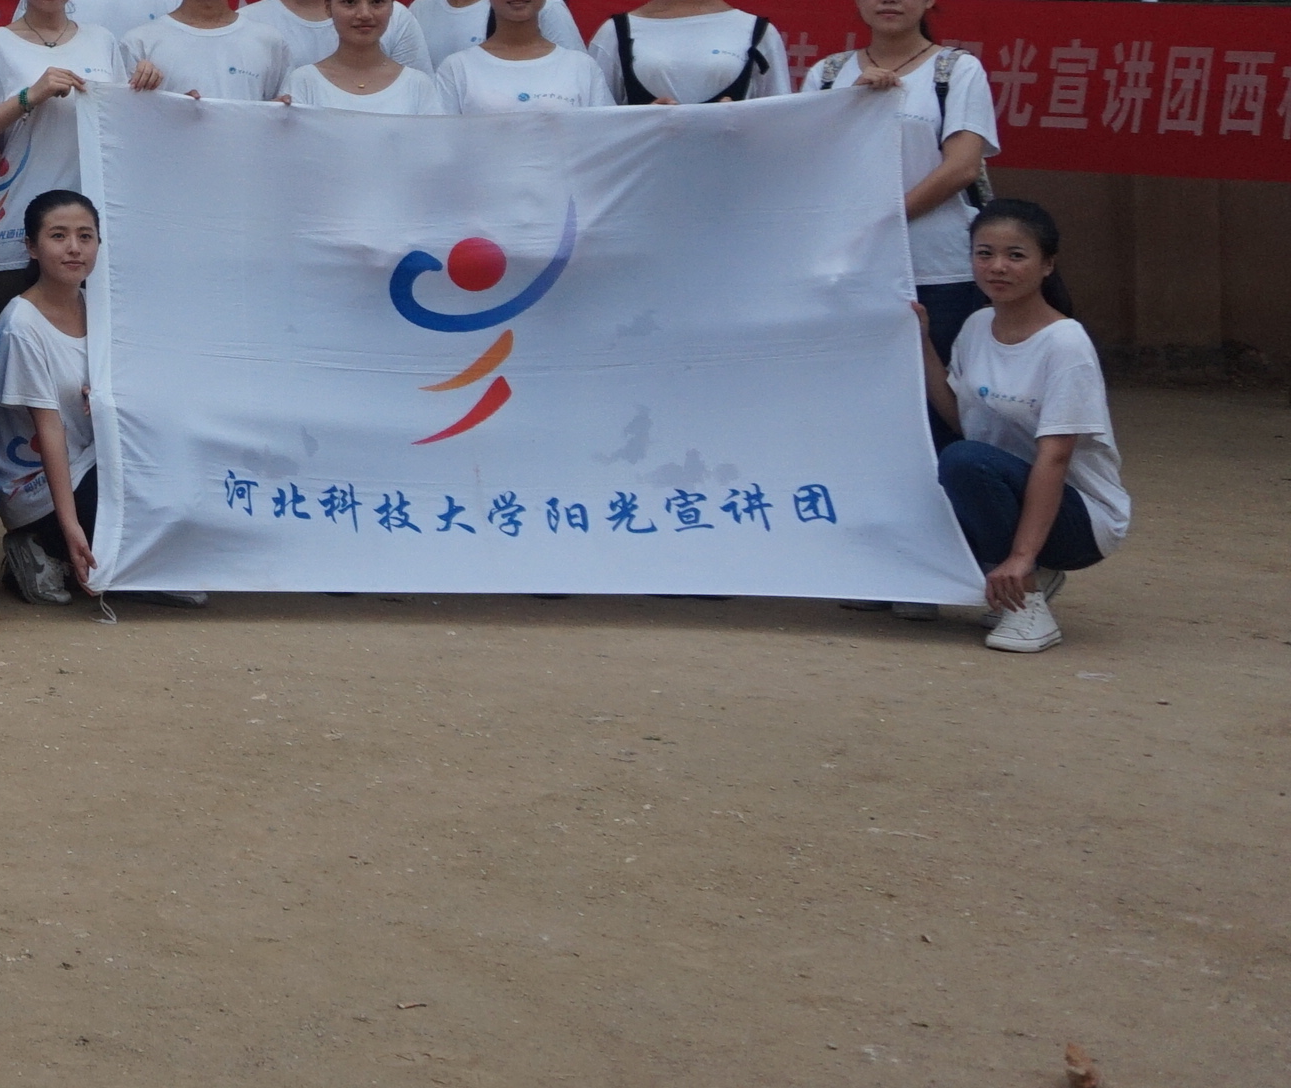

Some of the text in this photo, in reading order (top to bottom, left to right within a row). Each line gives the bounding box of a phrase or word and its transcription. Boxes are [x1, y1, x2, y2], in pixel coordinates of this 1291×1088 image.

[941, 36, 1291, 140] 光宣讲团西
[224, 469, 837, 537] 河北科技大学阳光宣讲团
